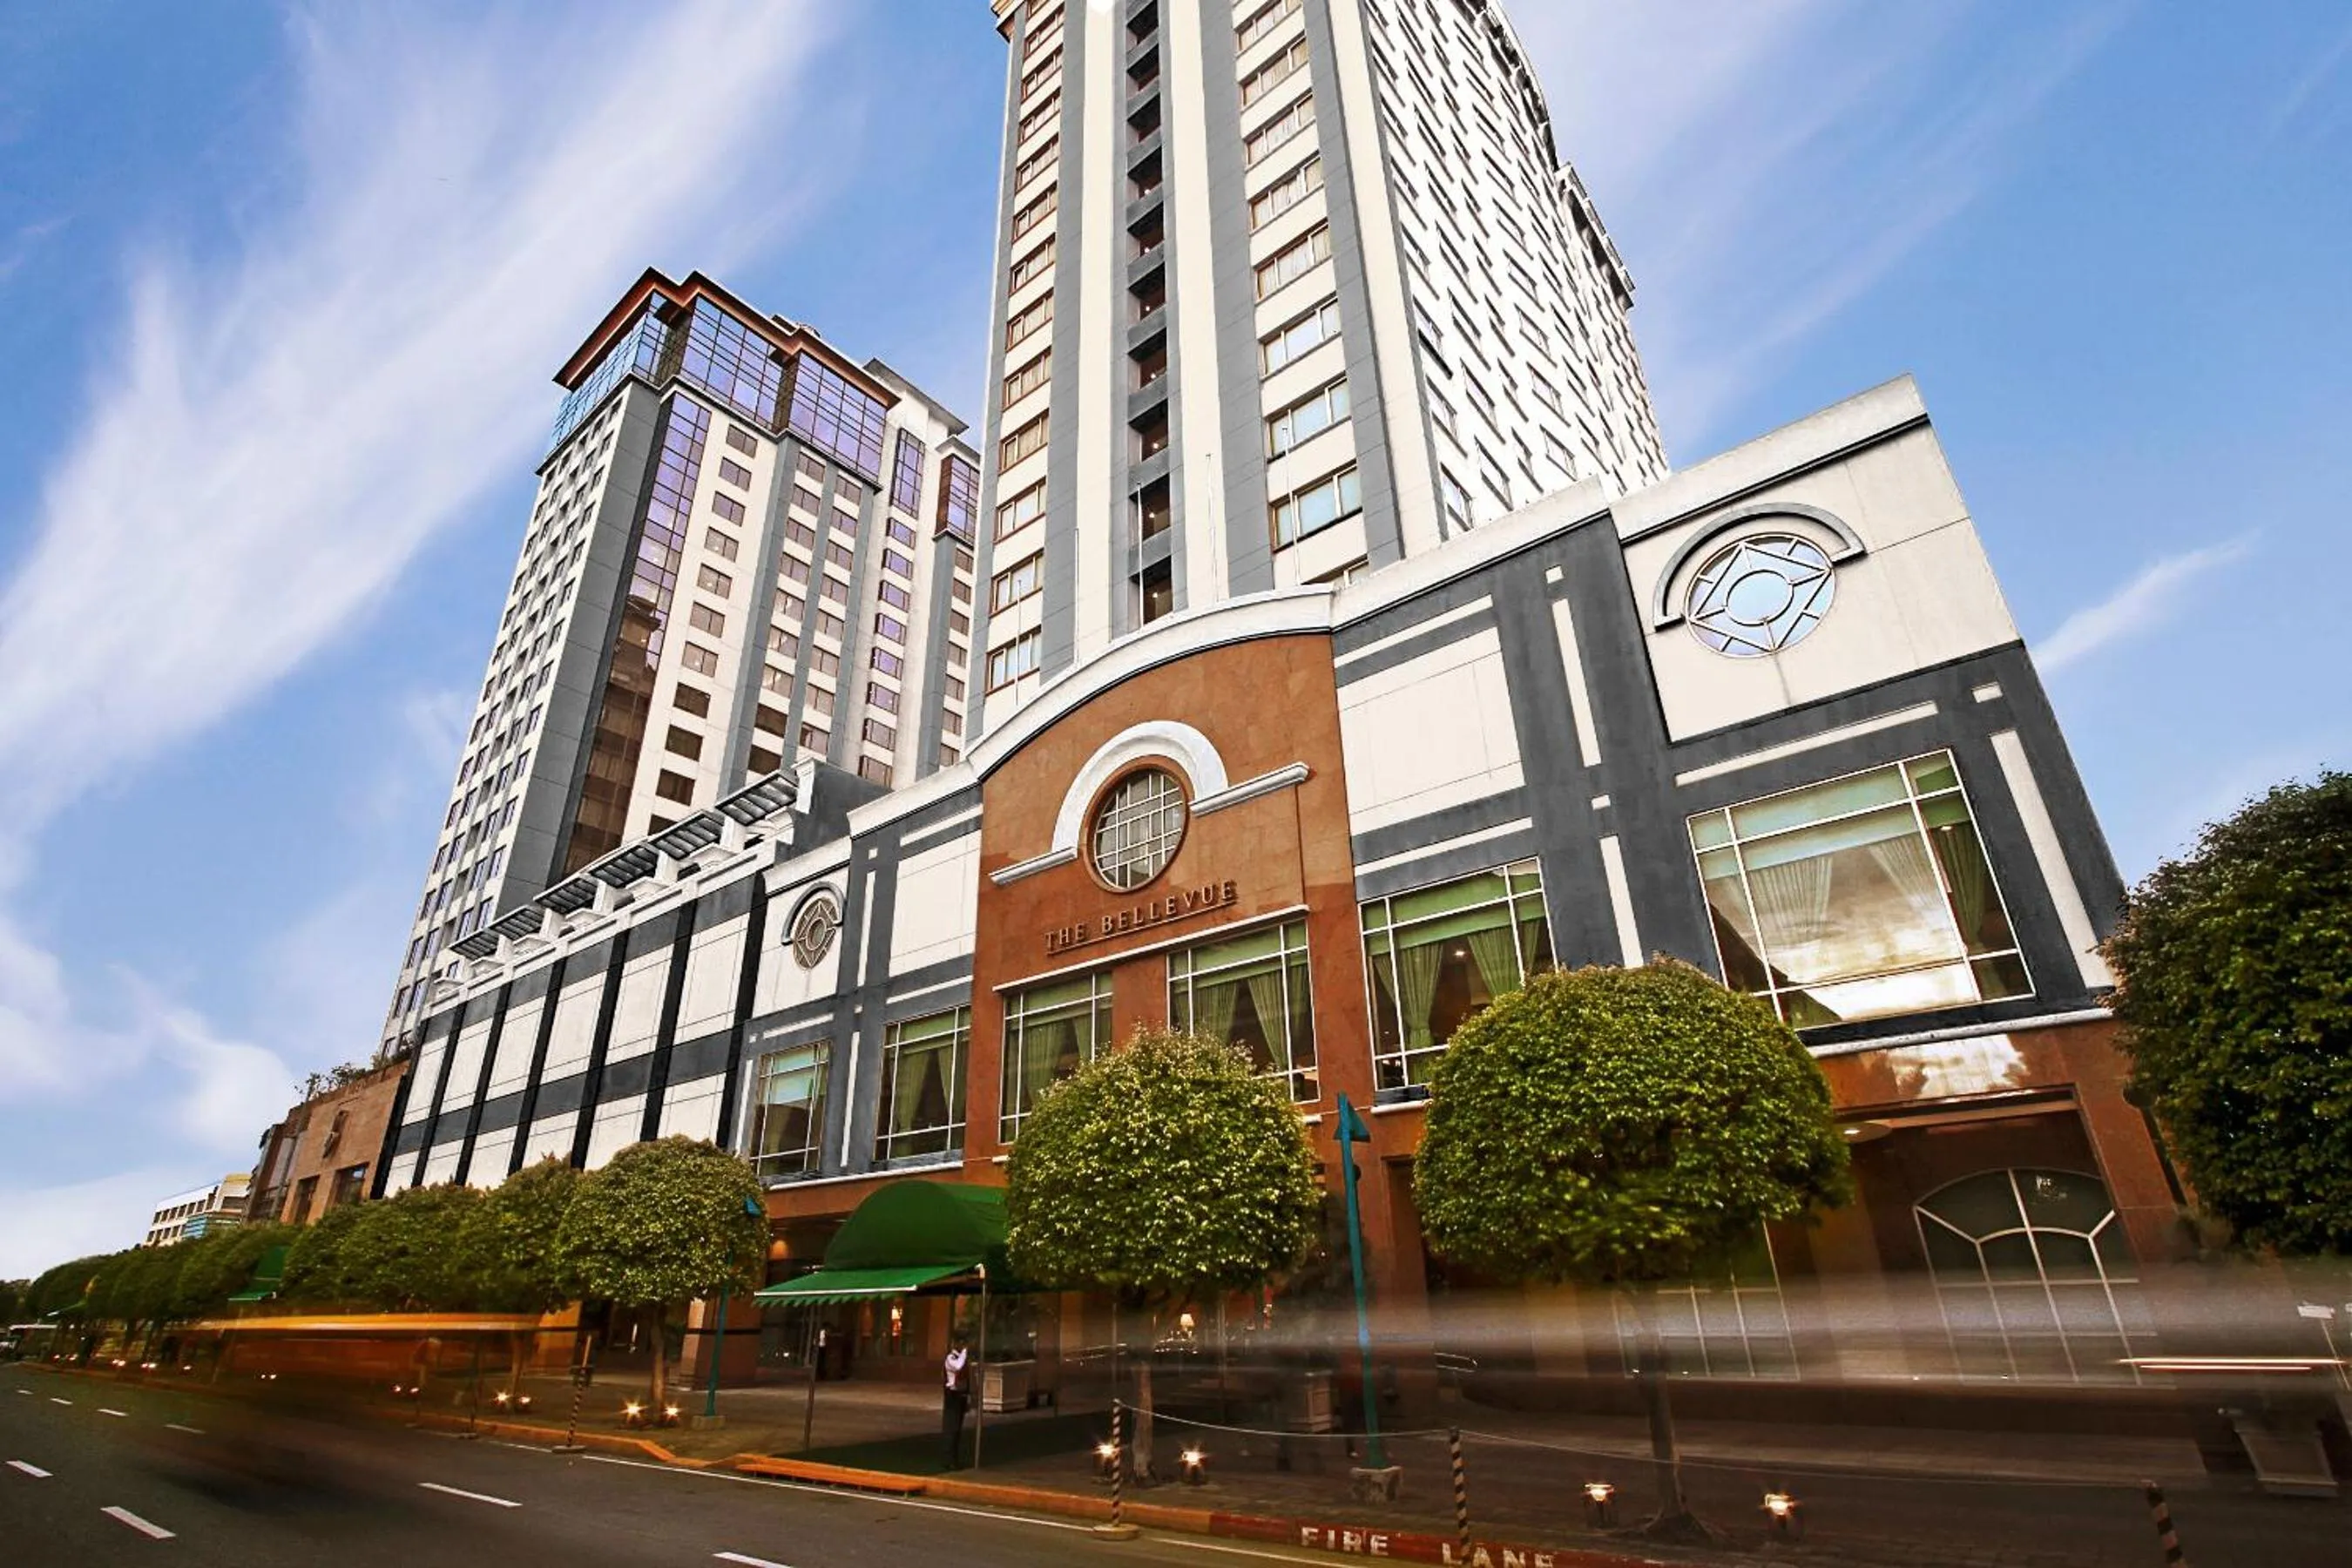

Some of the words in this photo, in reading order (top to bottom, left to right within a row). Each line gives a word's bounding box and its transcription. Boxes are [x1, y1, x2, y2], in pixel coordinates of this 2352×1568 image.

[1045, 923, 1087, 950] THE
[1101, 879, 1237, 935] BELLEVUE
[1301, 1526, 1389, 1556] FIRE
[1442, 1543, 1555, 1568] LANE
